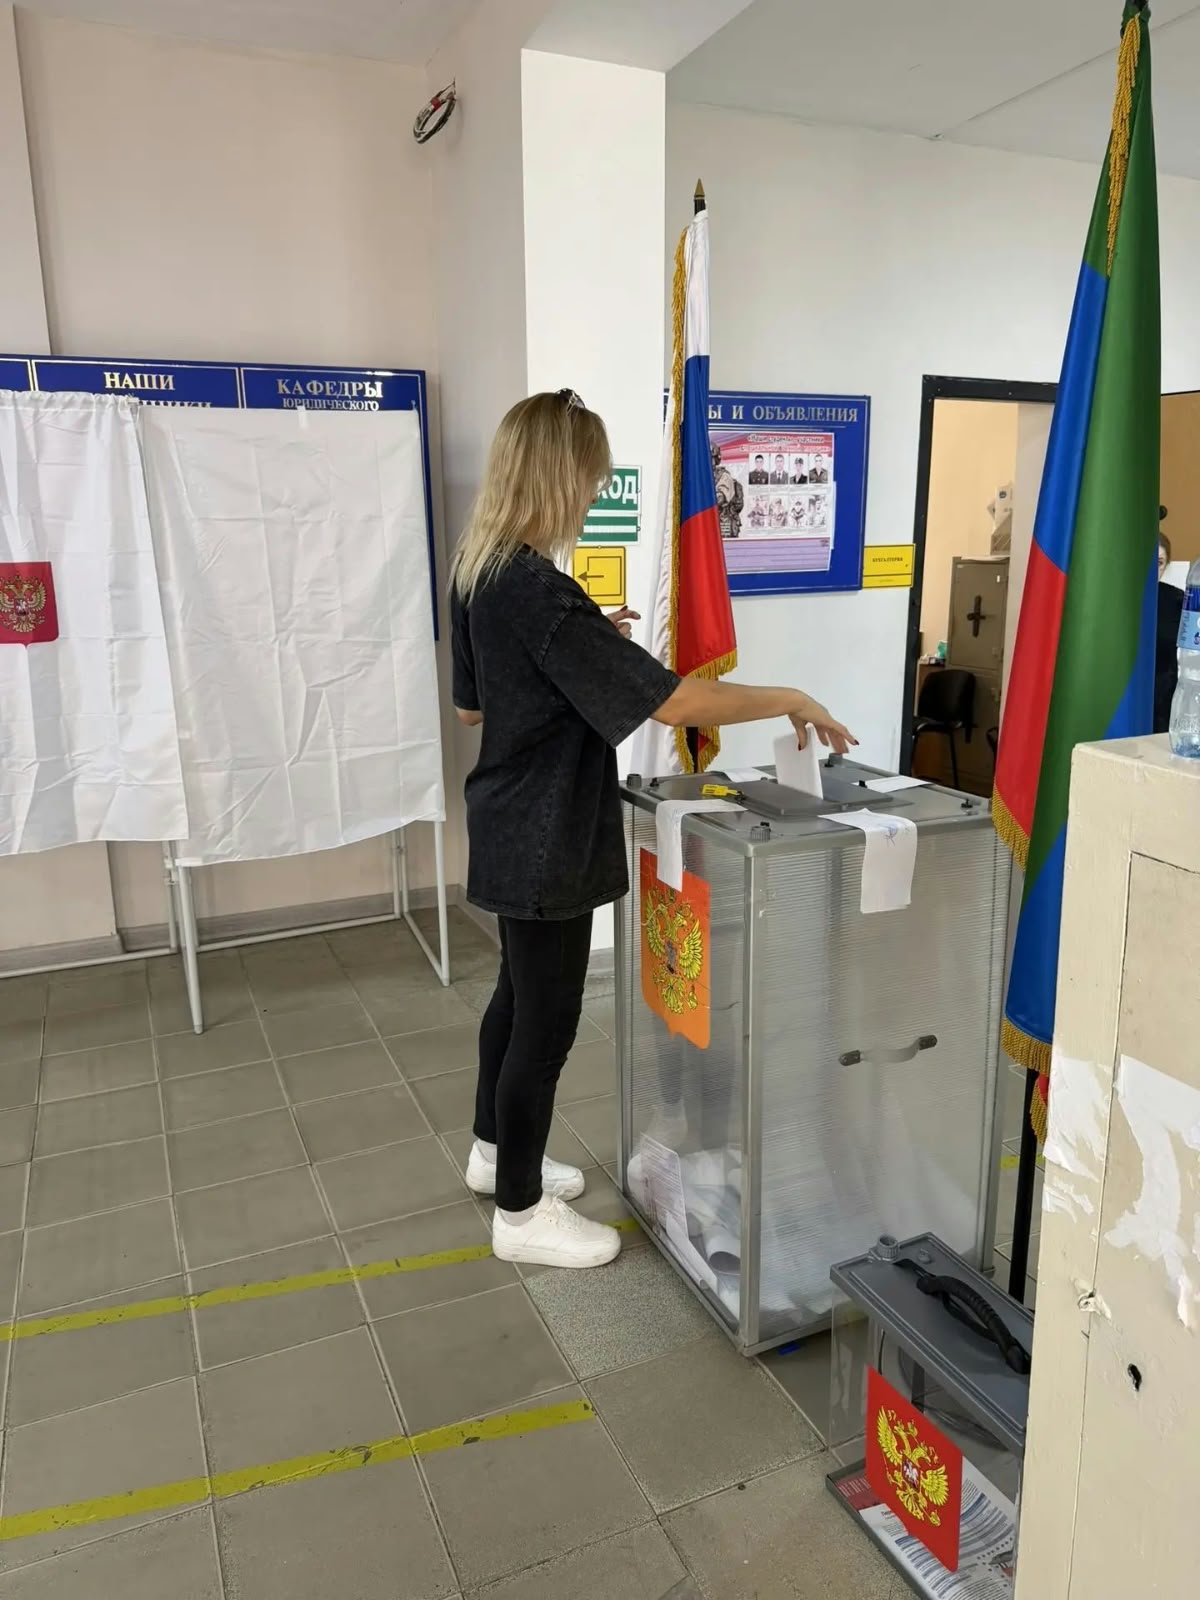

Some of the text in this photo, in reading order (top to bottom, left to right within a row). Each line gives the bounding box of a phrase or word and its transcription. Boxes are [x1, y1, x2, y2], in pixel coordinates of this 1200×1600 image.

[103, 372, 176, 390] НАШИ
[276, 379, 384, 399] КАФЕДРЫ
[731, 405, 745, 420] И
[752, 405, 859, 422] ОБЪЯВЛЕНИЯ
